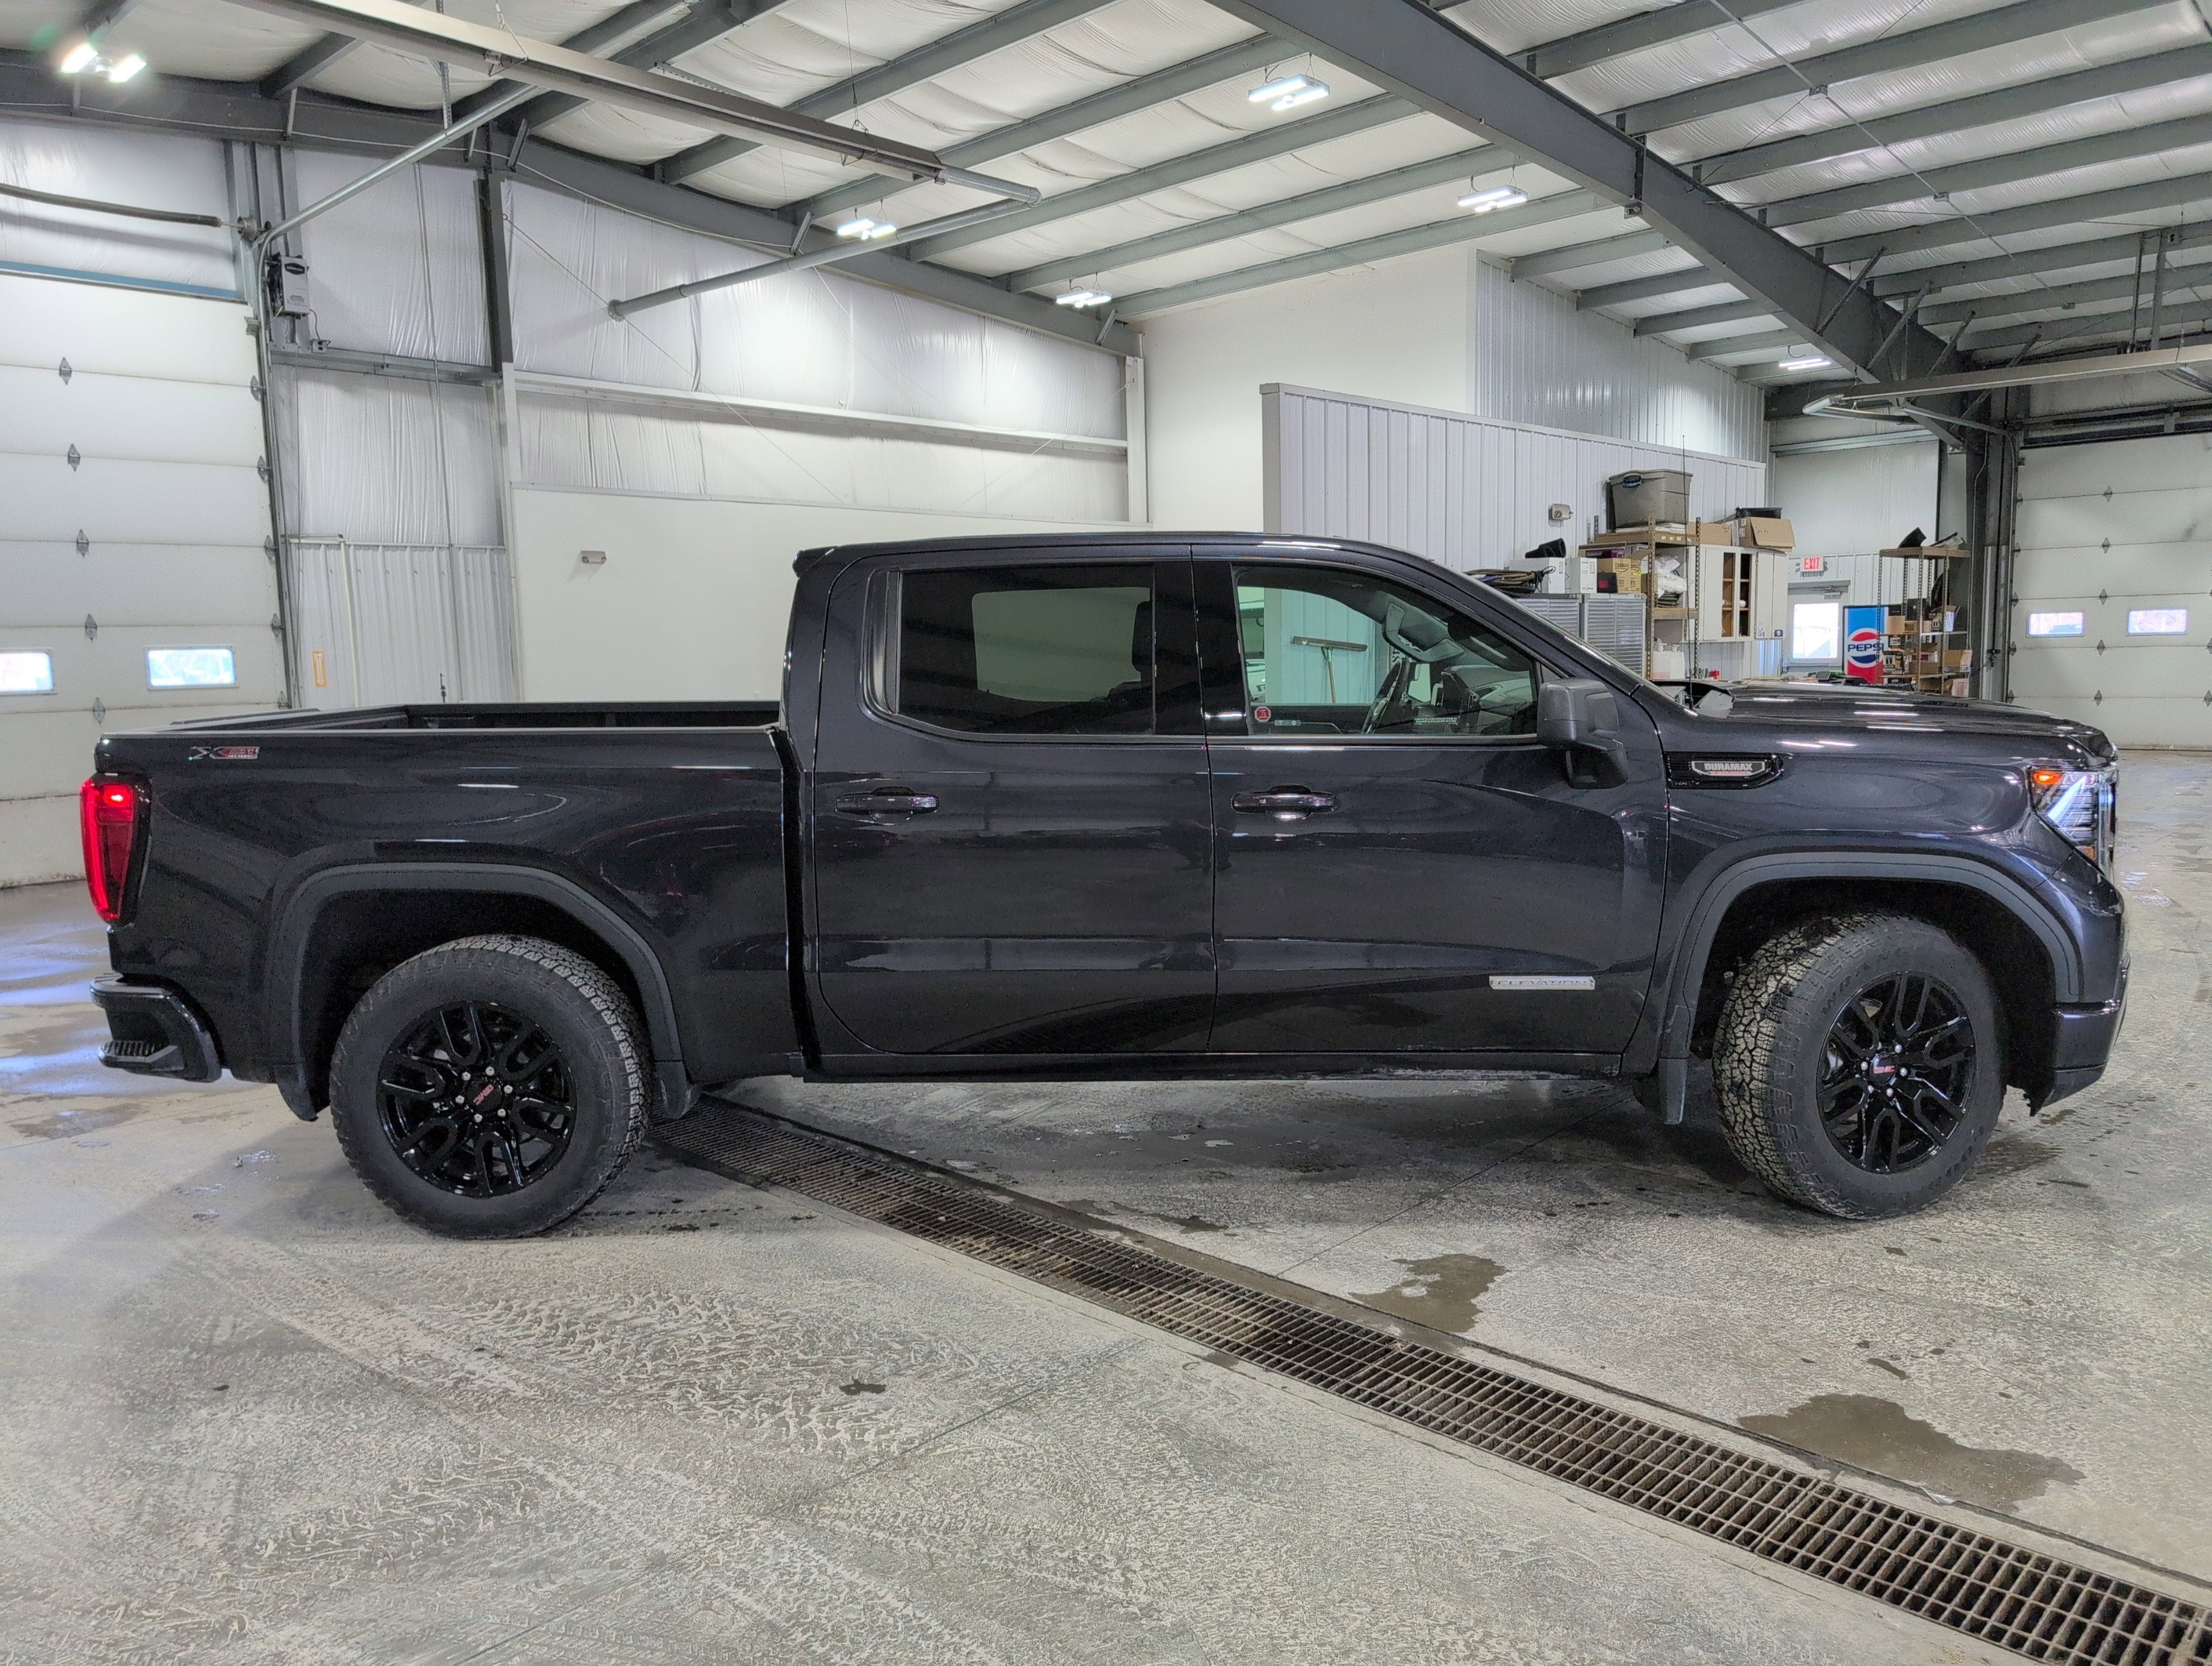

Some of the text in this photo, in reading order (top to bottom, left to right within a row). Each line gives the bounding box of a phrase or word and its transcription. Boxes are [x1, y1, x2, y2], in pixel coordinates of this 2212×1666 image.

[1804, 557, 1820, 569] EXIT
[1848, 643, 1885, 652] PEPSI
[1704, 762, 1753, 771] DURAMAX
[1874, 1065, 1895, 1074] GMC
[473, 1084, 494, 1105] GMC
